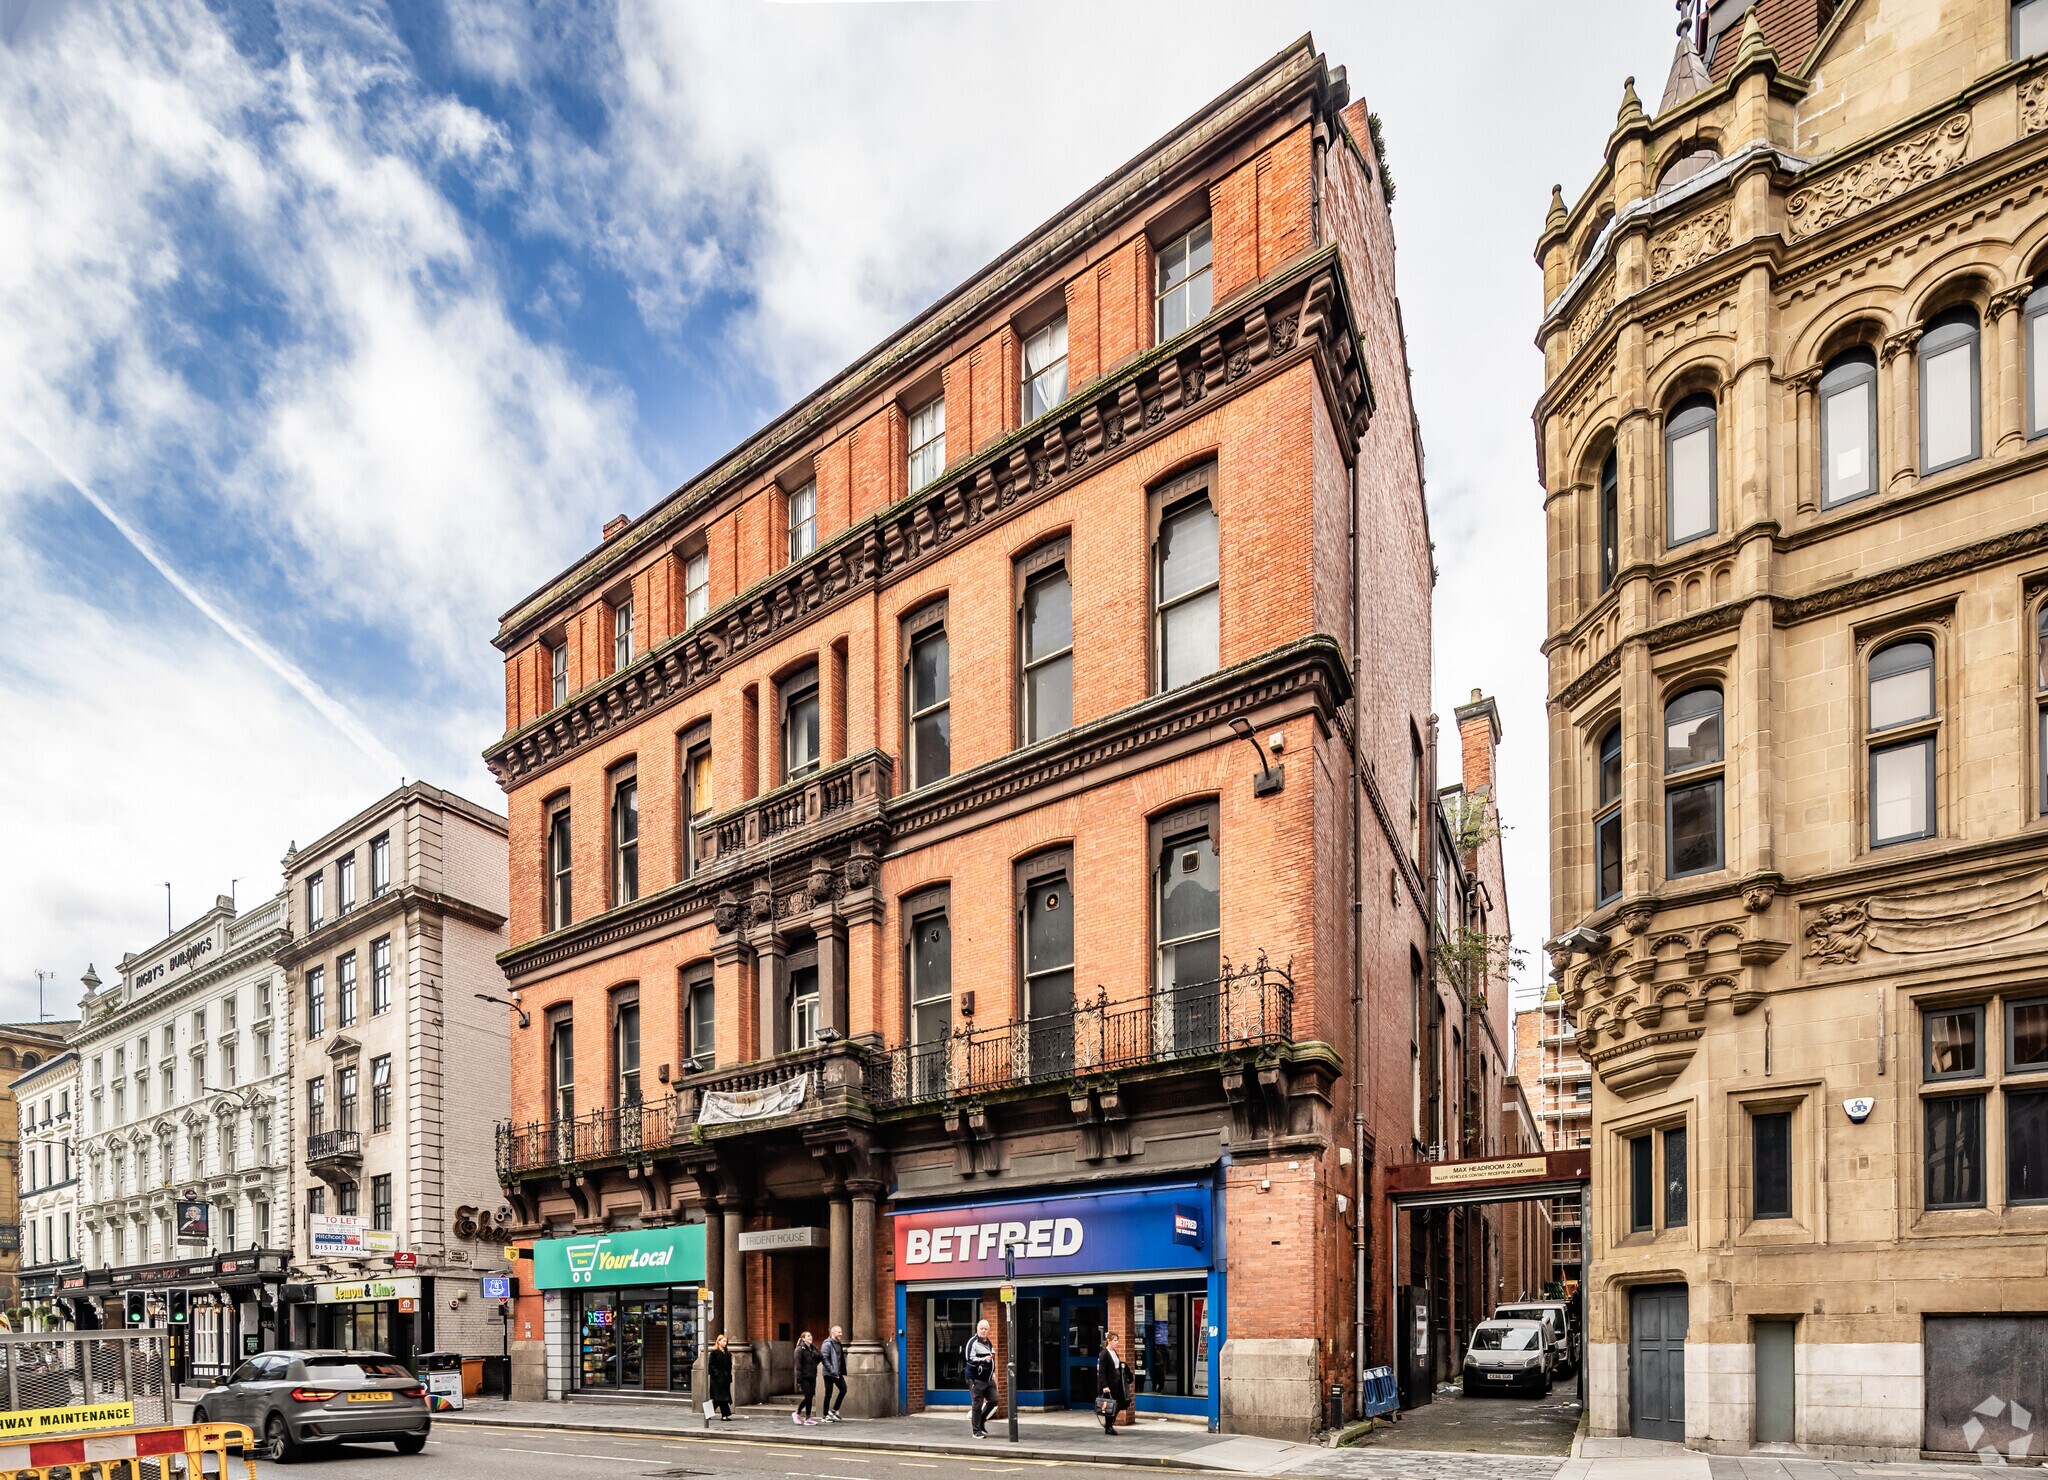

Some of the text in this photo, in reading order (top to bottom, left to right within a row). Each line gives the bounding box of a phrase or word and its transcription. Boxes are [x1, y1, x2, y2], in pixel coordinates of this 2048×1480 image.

[136, 937, 212, 989] RIGBY'S BUILDINGS
[1468, 1164, 1504, 1172] HEADROOM
[324, 1216, 337, 1224] TO
[346, 1234, 360, 1242] Wrig
[746, 1232, 804, 1246] TRIDENT HOUSE
[906, 1218, 1084, 1264] BETFRED
[334, 1282, 396, 1300] Lemon & Lime
[40, 1408, 130, 1426] MAINTENANCE
